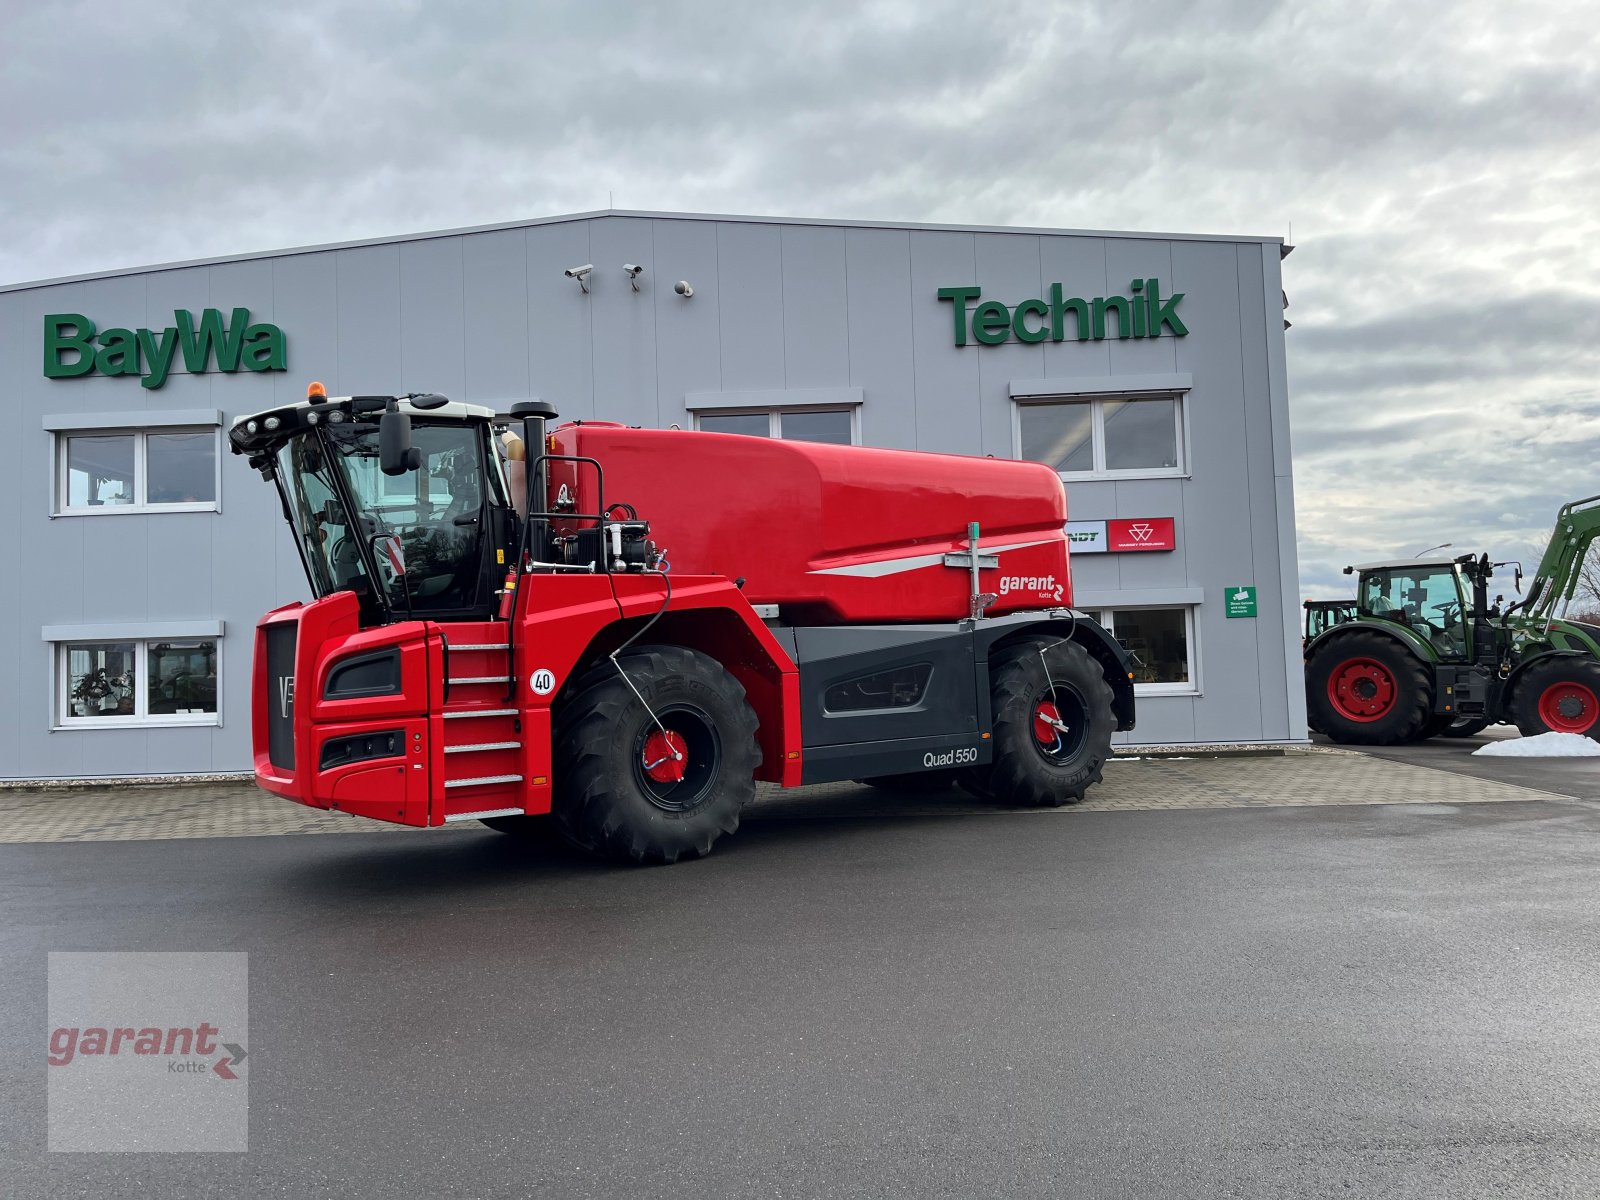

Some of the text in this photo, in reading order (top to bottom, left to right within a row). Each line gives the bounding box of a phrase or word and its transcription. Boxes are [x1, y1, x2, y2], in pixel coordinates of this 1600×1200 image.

[937, 278, 1190, 347] Technik
[44, 308, 287, 390] BayWa
[1000, 575, 1055, 595] garant
[535, 674, 550, 690] 40
[923, 747, 978, 767] Quad 550
